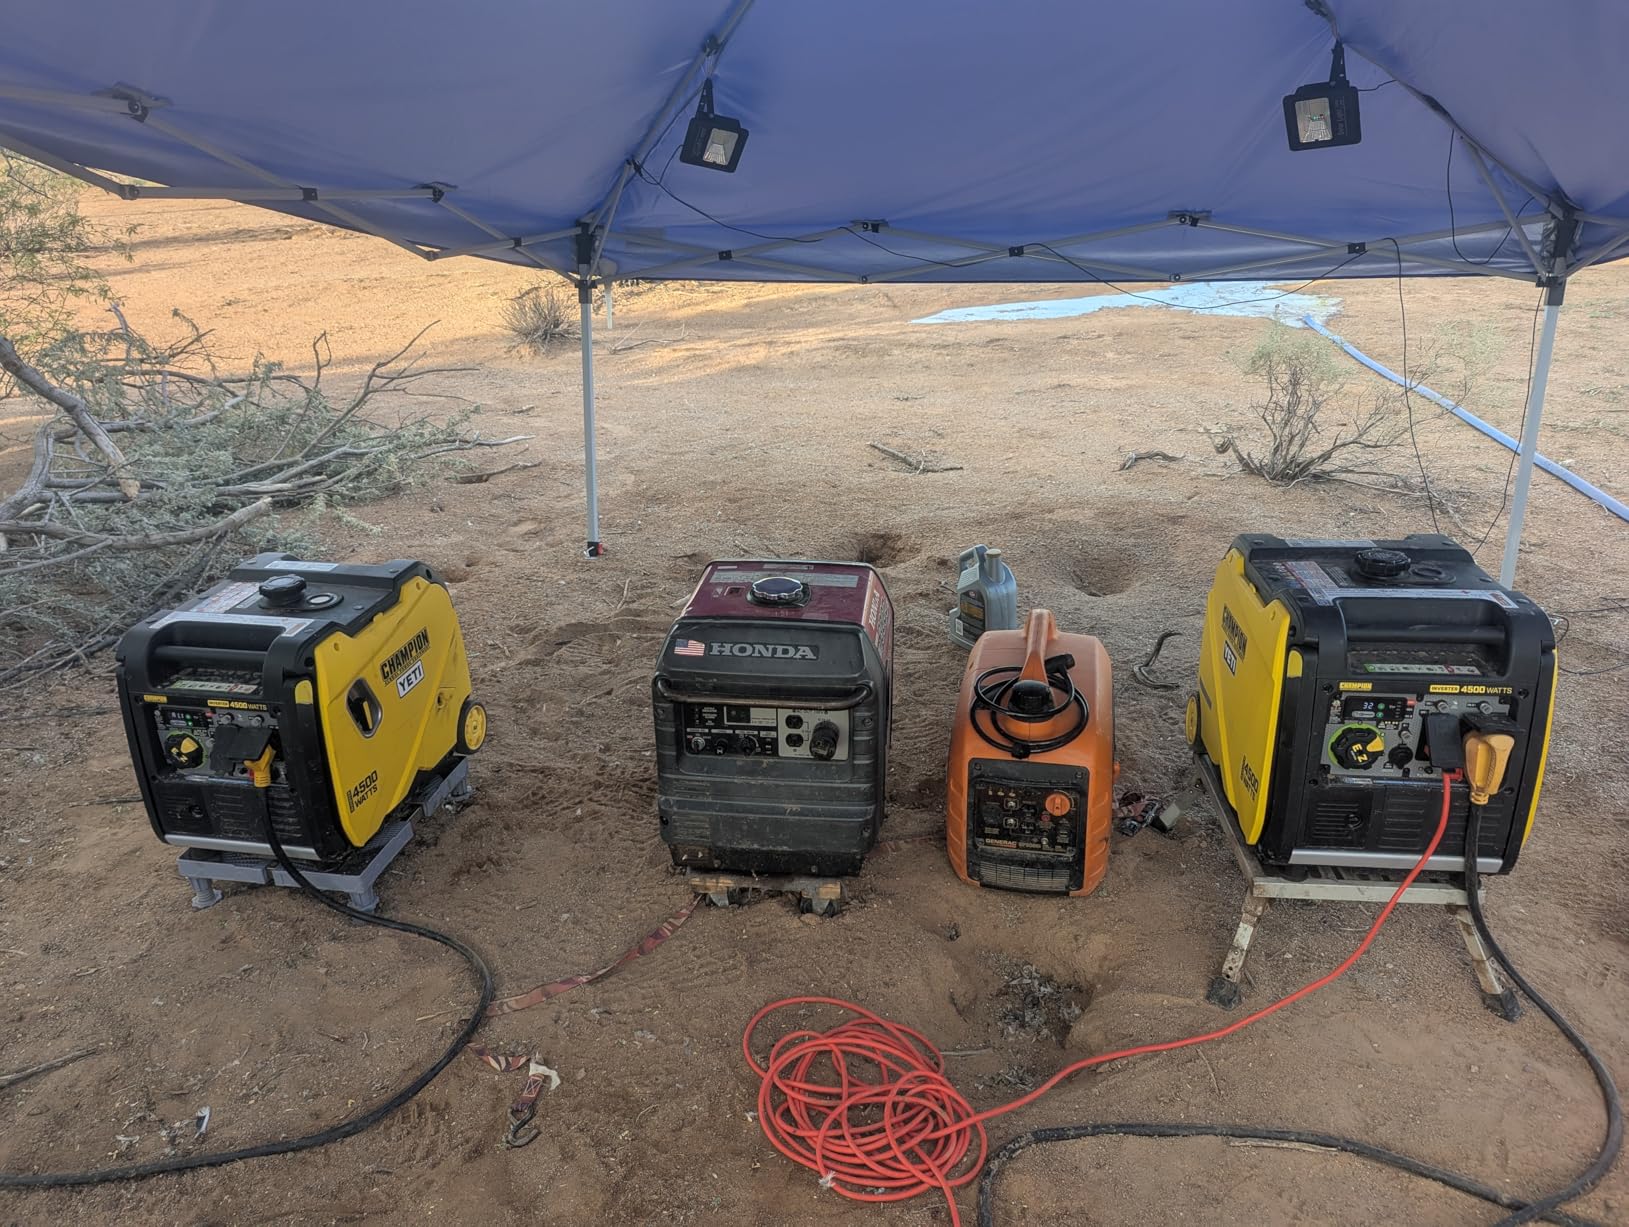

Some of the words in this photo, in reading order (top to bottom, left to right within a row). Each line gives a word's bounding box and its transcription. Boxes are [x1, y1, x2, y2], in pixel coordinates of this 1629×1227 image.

[381, 628, 429, 680] CHAMPION
[709, 642, 816, 659] HONDA
[1225, 646, 1236, 673] YETI
[399, 665, 422, 692] YETI
[1461, 685, 1486, 694] 4500
[230, 701, 248, 709] 4500
[248, 703, 267, 711] WATTS
[1363, 702, 1374, 710] 32
[353, 770, 378, 798] 4500
[355, 784, 378, 808] WATTS
